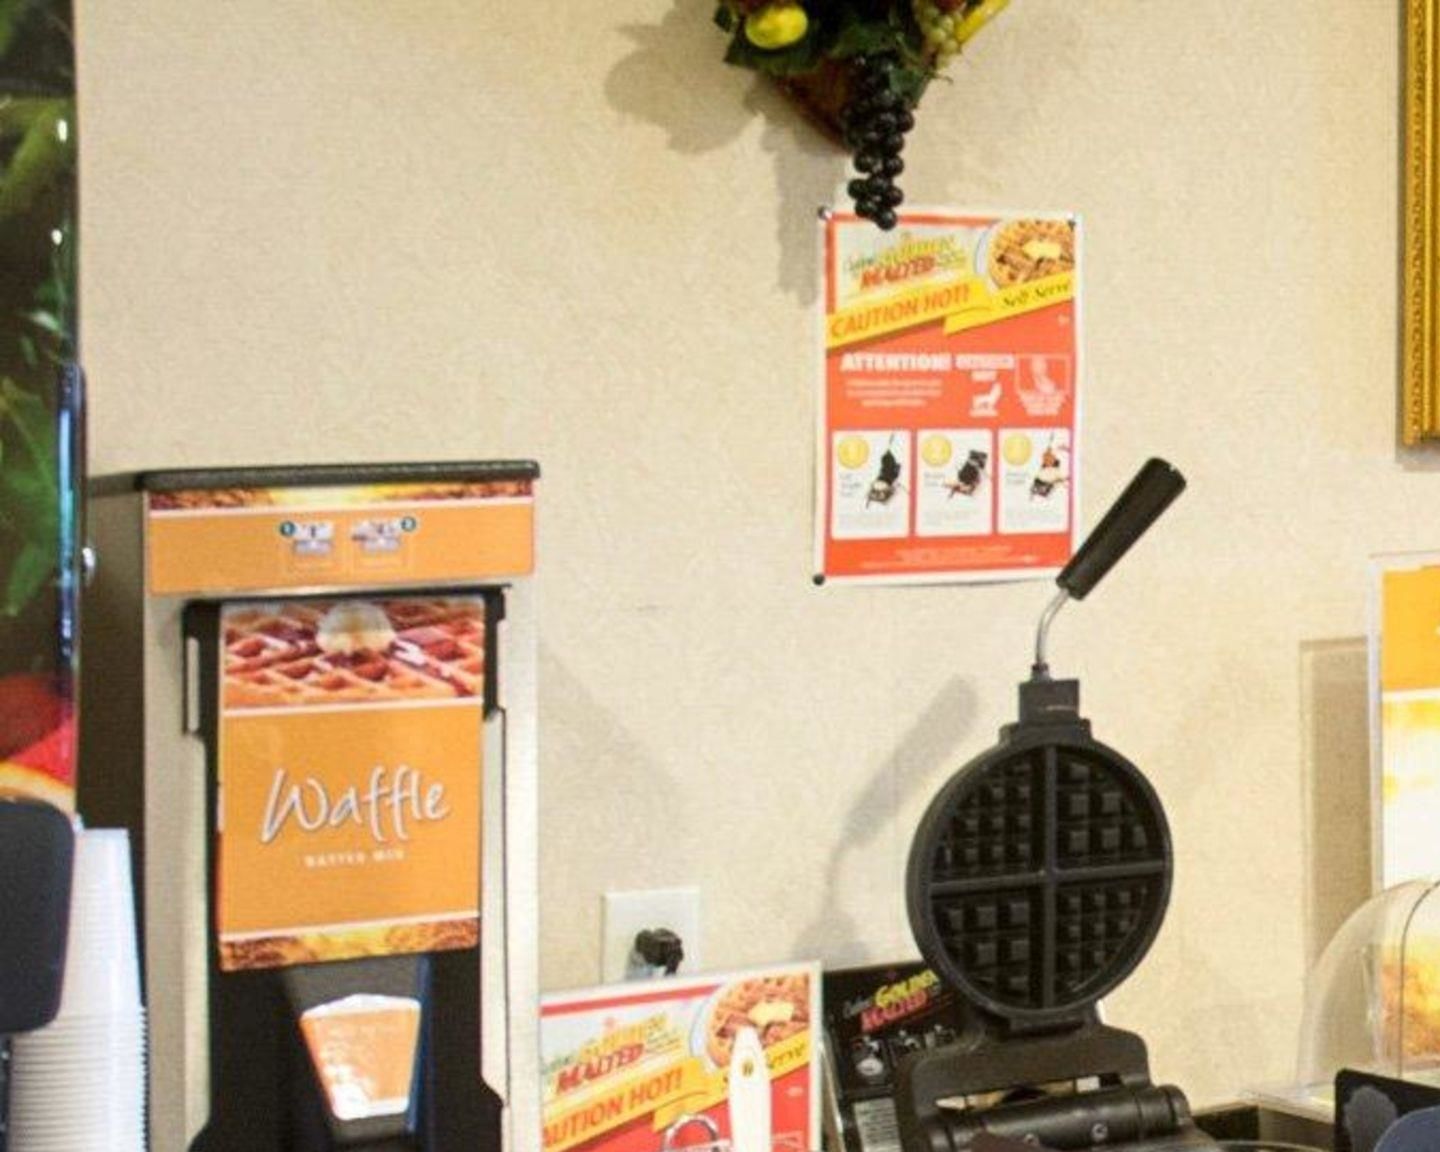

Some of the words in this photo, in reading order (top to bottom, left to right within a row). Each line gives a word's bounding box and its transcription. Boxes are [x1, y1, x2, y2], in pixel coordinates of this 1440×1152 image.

[830, 295, 918, 339] CAUTION
[260, 765, 450, 843] Waffle
[630, 1066, 683, 1110] HOT!
